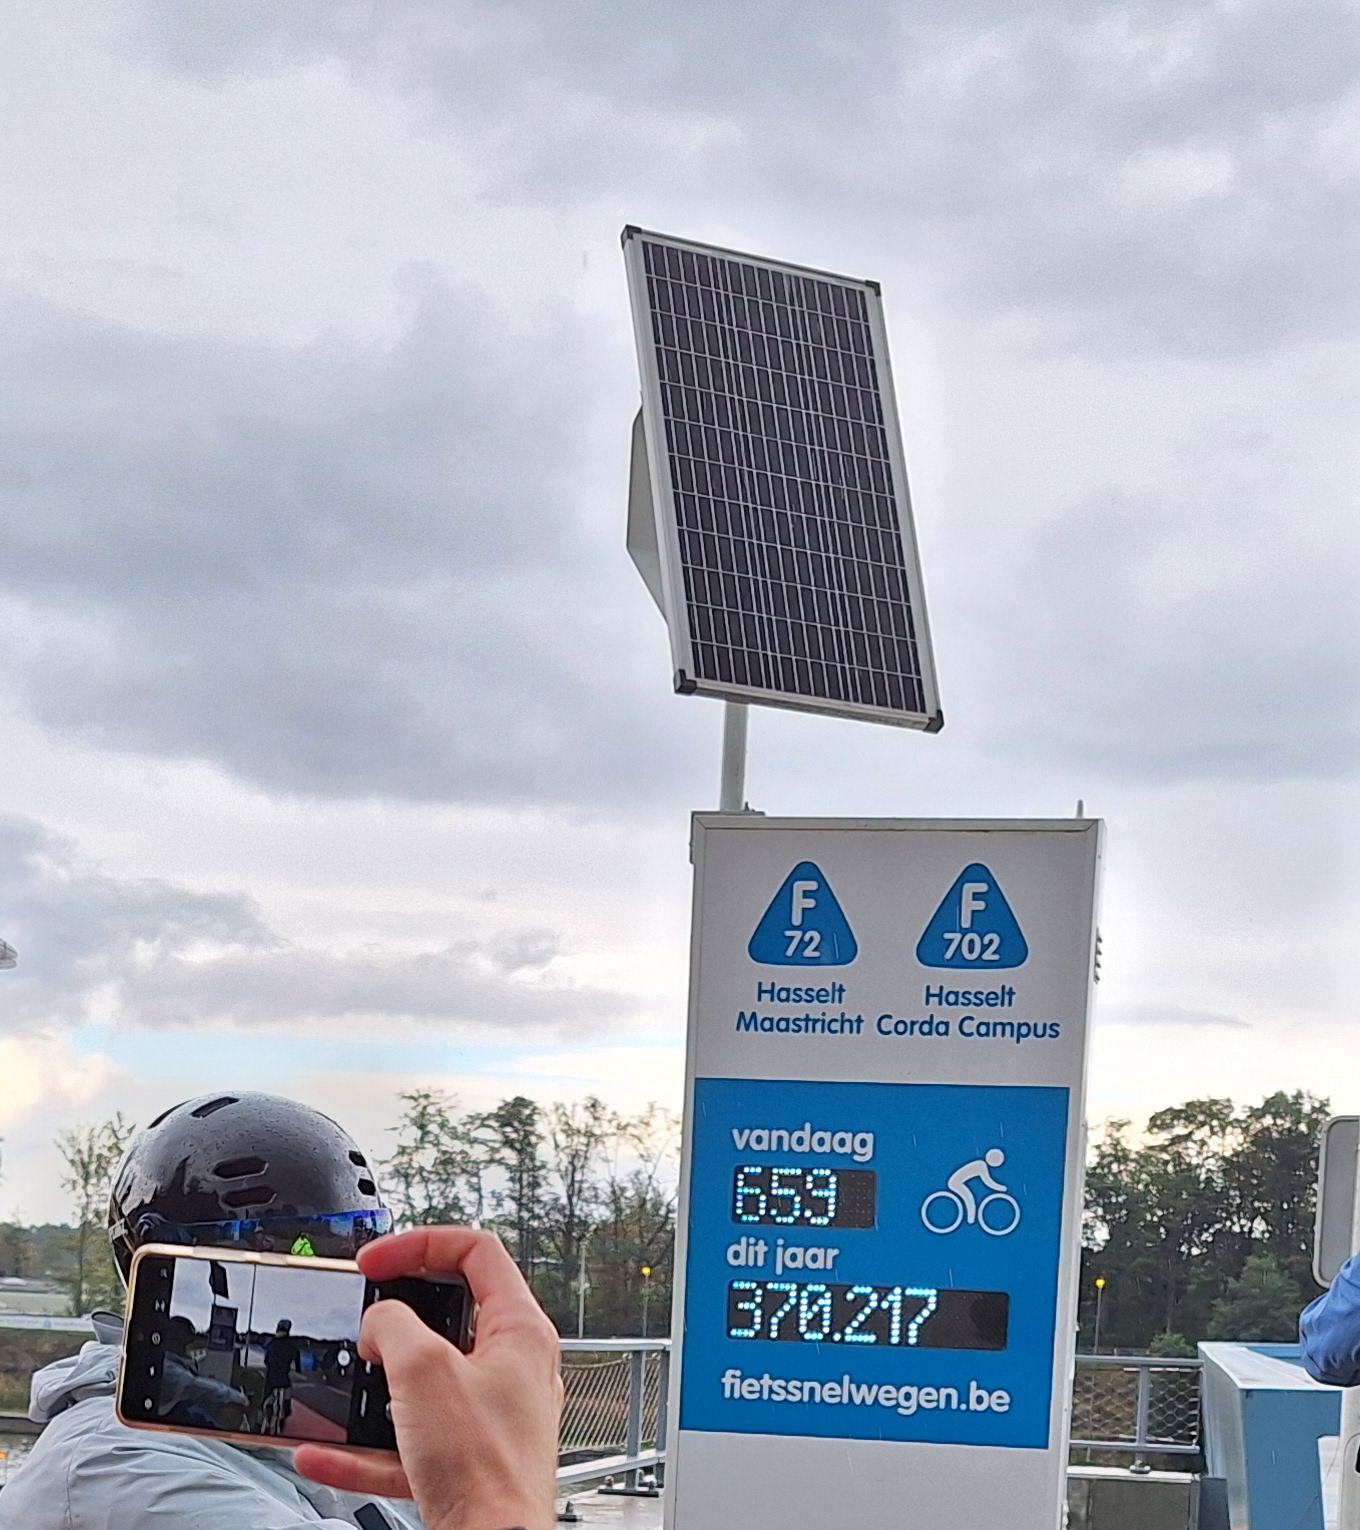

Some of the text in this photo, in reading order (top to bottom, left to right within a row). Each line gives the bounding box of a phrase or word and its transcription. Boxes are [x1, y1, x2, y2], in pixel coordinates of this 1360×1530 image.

[791, 880, 818, 926] F
[960, 882, 988, 928] F
[784, 930, 821, 957] 72
[943, 932, 1001, 961] 702
[757, 981, 846, 1005] Hasselt
[925, 985, 1016, 1008] Hasselt
[736, 1011, 864, 1035] Maastricht
[876, 1014, 1060, 1044] Corda Campus
[732, 1122, 875, 1161] vandaag
[735, 1166, 838, 1225] 659
[726, 1236, 839, 1275] dit jaar
[730, 1280, 938, 1345] 370.217
[721, 1369, 1011, 1415] fietssnelwegen.be
